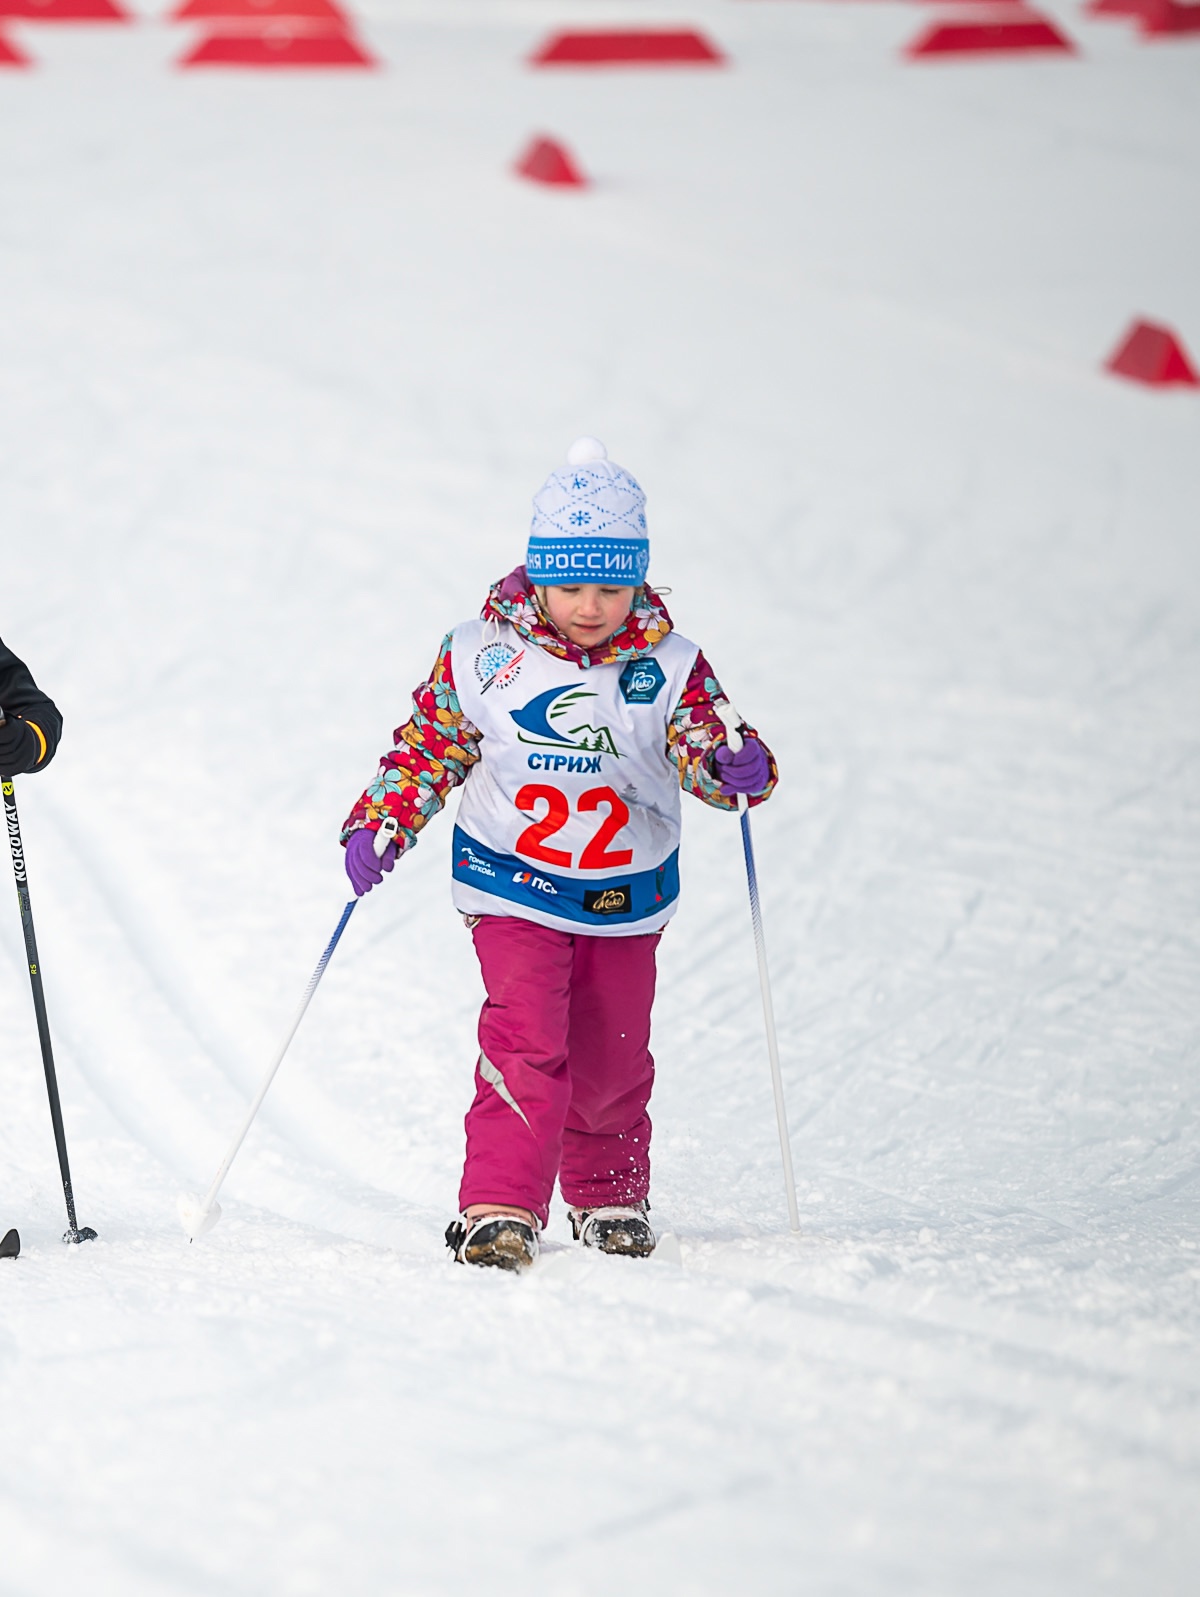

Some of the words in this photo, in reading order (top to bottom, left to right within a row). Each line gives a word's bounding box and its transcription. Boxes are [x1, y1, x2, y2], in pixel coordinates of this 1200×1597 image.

[545, 553, 632, 570] РОССИИ
[527, 752, 602, 774] СТРИЖ
[514, 783, 633, 869] 22
